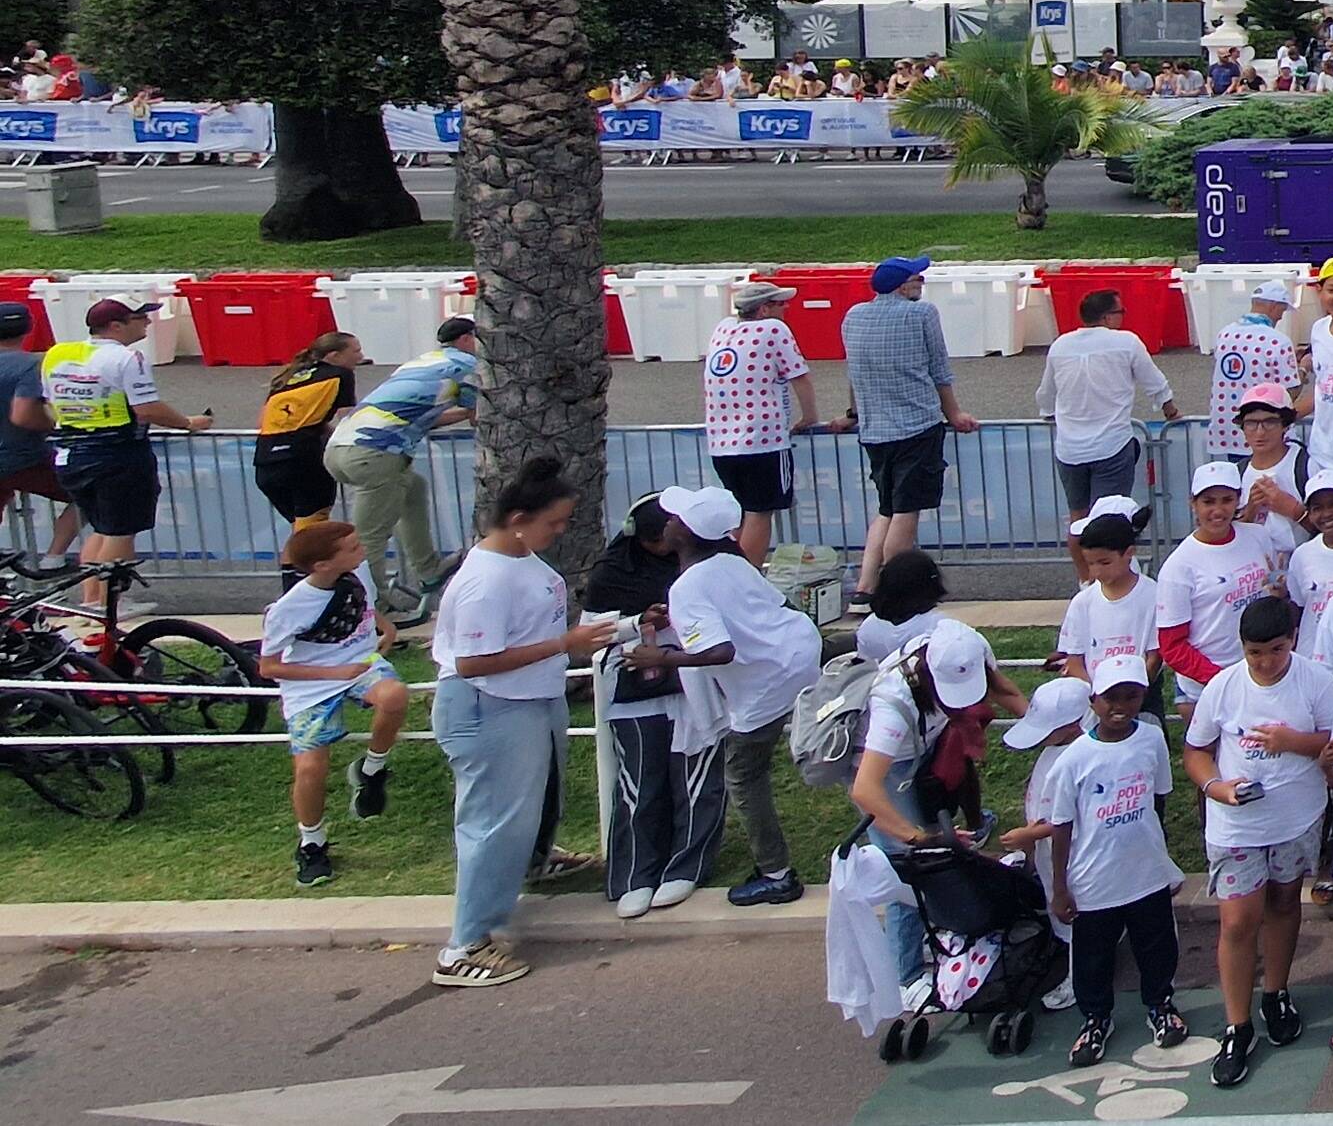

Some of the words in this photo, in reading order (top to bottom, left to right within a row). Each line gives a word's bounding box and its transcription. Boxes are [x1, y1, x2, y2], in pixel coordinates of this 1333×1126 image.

[1040, 5, 1062, 22] Krys
[0, 117, 45, 137] Krys
[143, 118, 190, 138] Krys
[601, 115, 649, 136] Krys
[750, 114, 800, 137] Krys
[1205, 164, 1233, 238] cap
[1238, 568, 1266, 586] POUR
[1225, 587, 1246, 604] QUE
[1246, 584, 1258, 597] LE
[1104, 646, 1136, 658] POUR
[1117, 785, 1147, 801] POUR
[1096, 801, 1125, 819] QUE
[1126, 798, 1140, 811] LE
[1105, 807, 1146, 830] SPORT
